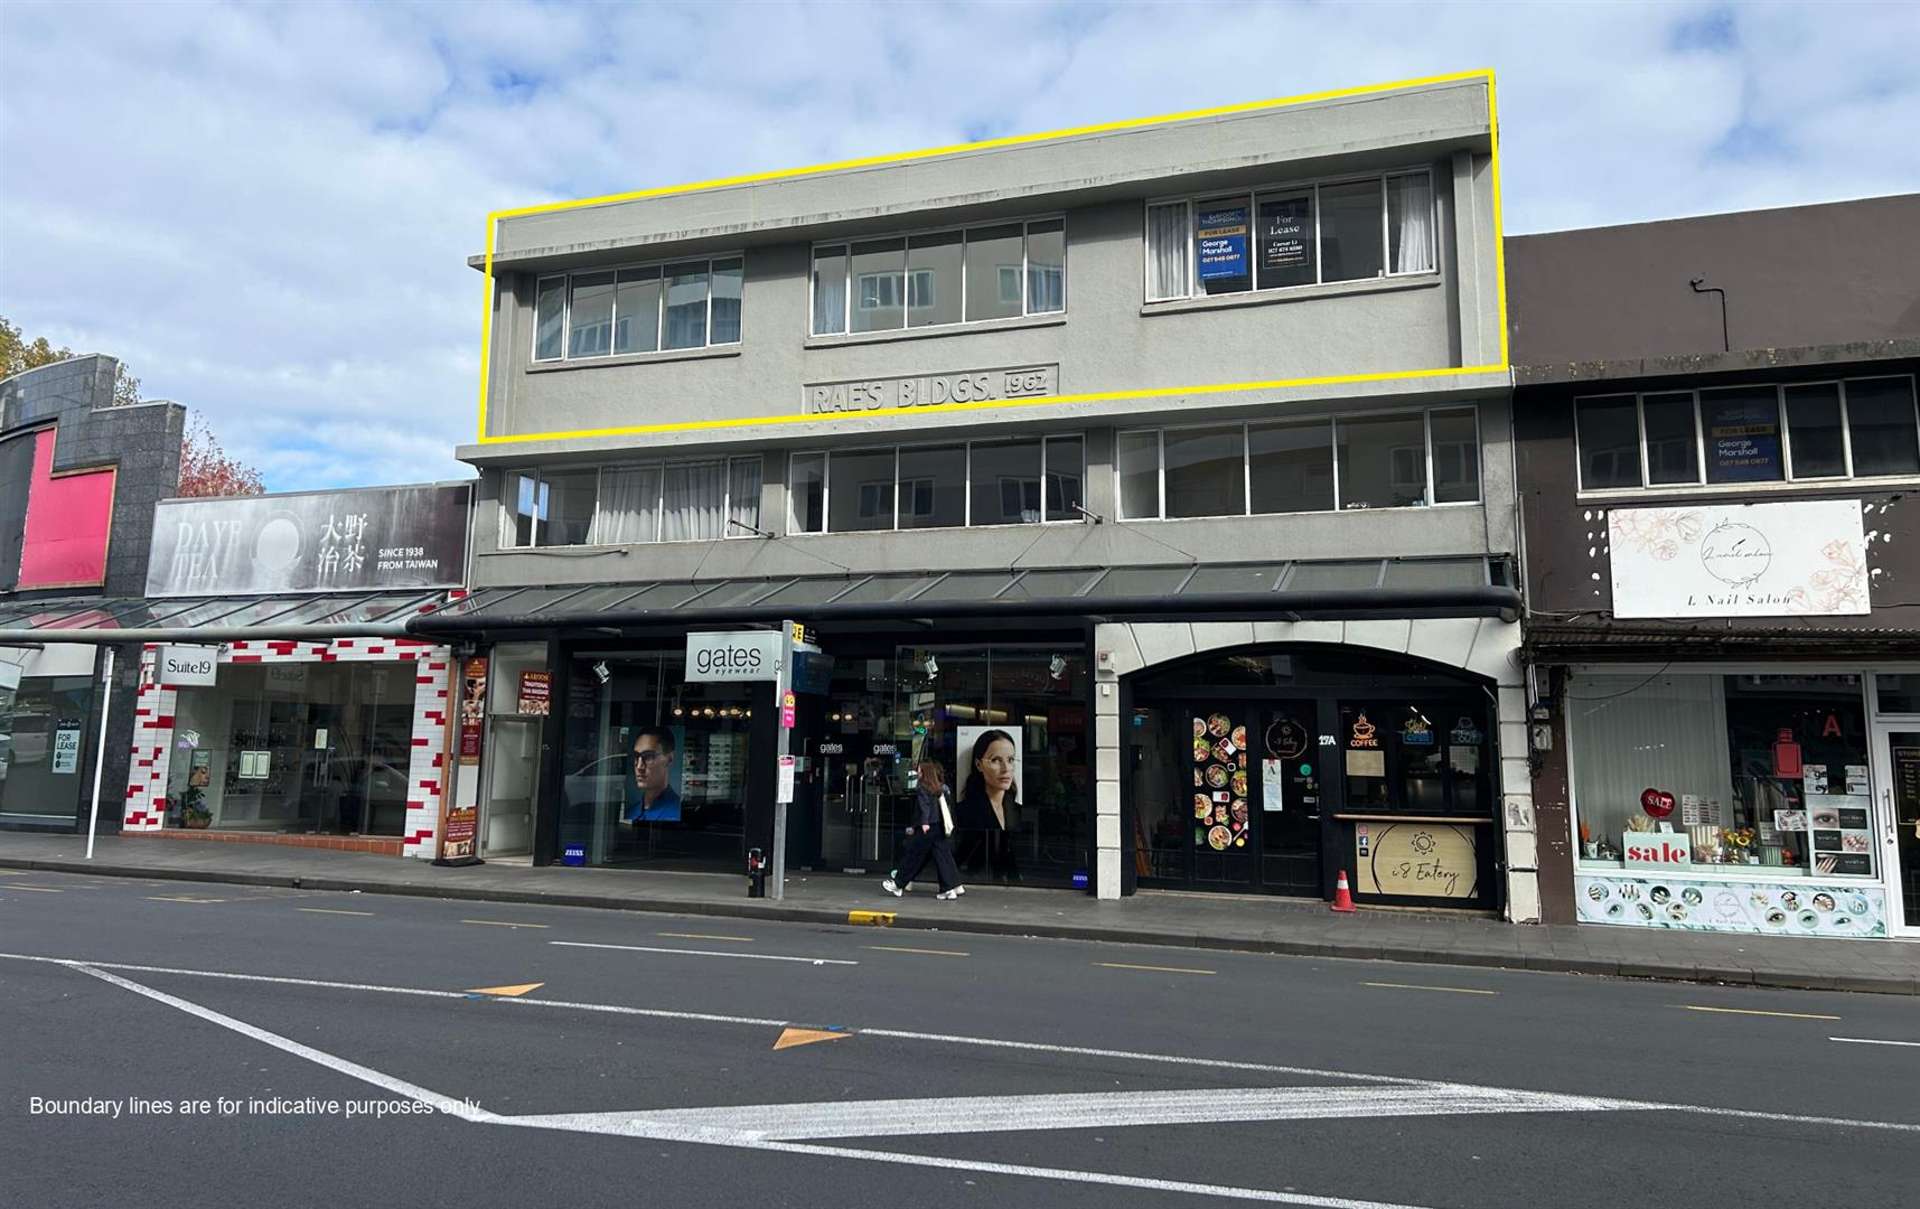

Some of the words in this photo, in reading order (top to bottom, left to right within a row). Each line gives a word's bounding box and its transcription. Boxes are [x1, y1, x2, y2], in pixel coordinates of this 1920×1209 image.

[1276, 215, 1293, 224] For
[1270, 226, 1299, 235] Lease
[1202, 246, 1232, 254] Marshall
[812, 382, 883, 414] RAE'S
[898, 374, 996, 408] BLDGS.
[1004, 373, 1047, 393] 1962
[1718, 440, 1752, 449] George
[1718, 448, 1758, 456] Marshall
[378, 548, 404, 558] SINCE
[405, 547, 424, 557] 1938
[174, 552, 218, 579] TEA
[377, 560, 403, 570] FROM
[405, 559, 438, 569] TAIWAN
[1707, 594, 1738, 604] Nail
[1746, 593, 1790, 604] Salon
[697, 644, 761, 674] gates
[167, 659, 211, 675] Suite19
[715, 668, 761, 677] eyewear
[58, 733, 71, 741] FOR
[1318, 735, 1336, 745] 17A
[56, 741, 76, 750] LEASE
[819, 743, 843, 754] gates
[1350, 739, 1378, 747] COFFEE
[872, 744, 897, 755] gates
[1647, 794, 1673, 810] SALE
[1628, 842, 1686, 863] sale
[1415, 857, 1460, 896] Eatery
